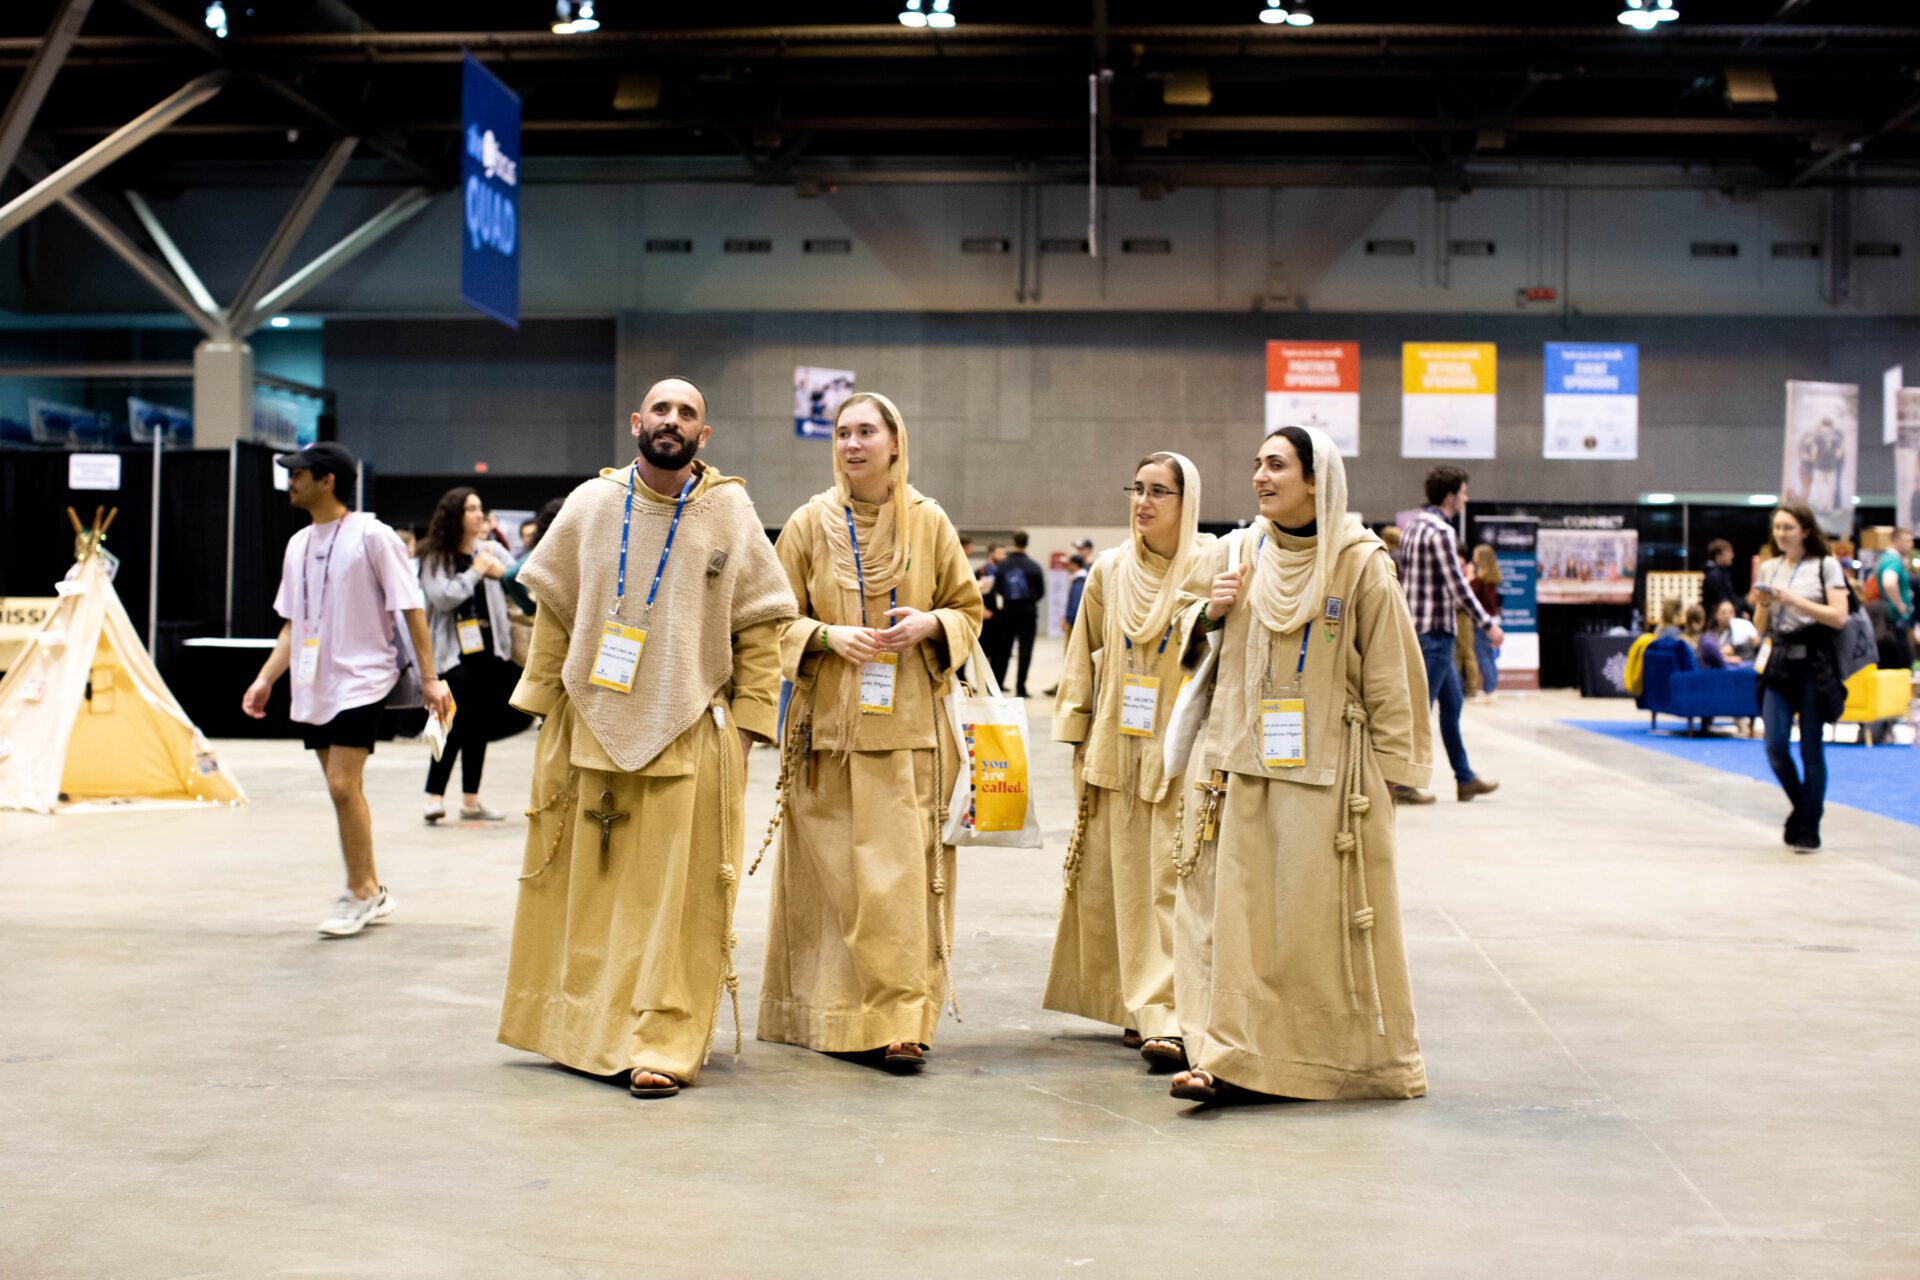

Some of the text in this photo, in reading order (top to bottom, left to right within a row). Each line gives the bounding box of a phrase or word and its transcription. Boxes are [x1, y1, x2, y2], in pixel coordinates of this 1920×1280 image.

[466, 175, 516, 256] QUAD
[1562, 515, 1625, 528] CONNECT
[982, 760, 1008, 771] you
[982, 772, 1005, 781] are
[982, 781, 1024, 793] called.
